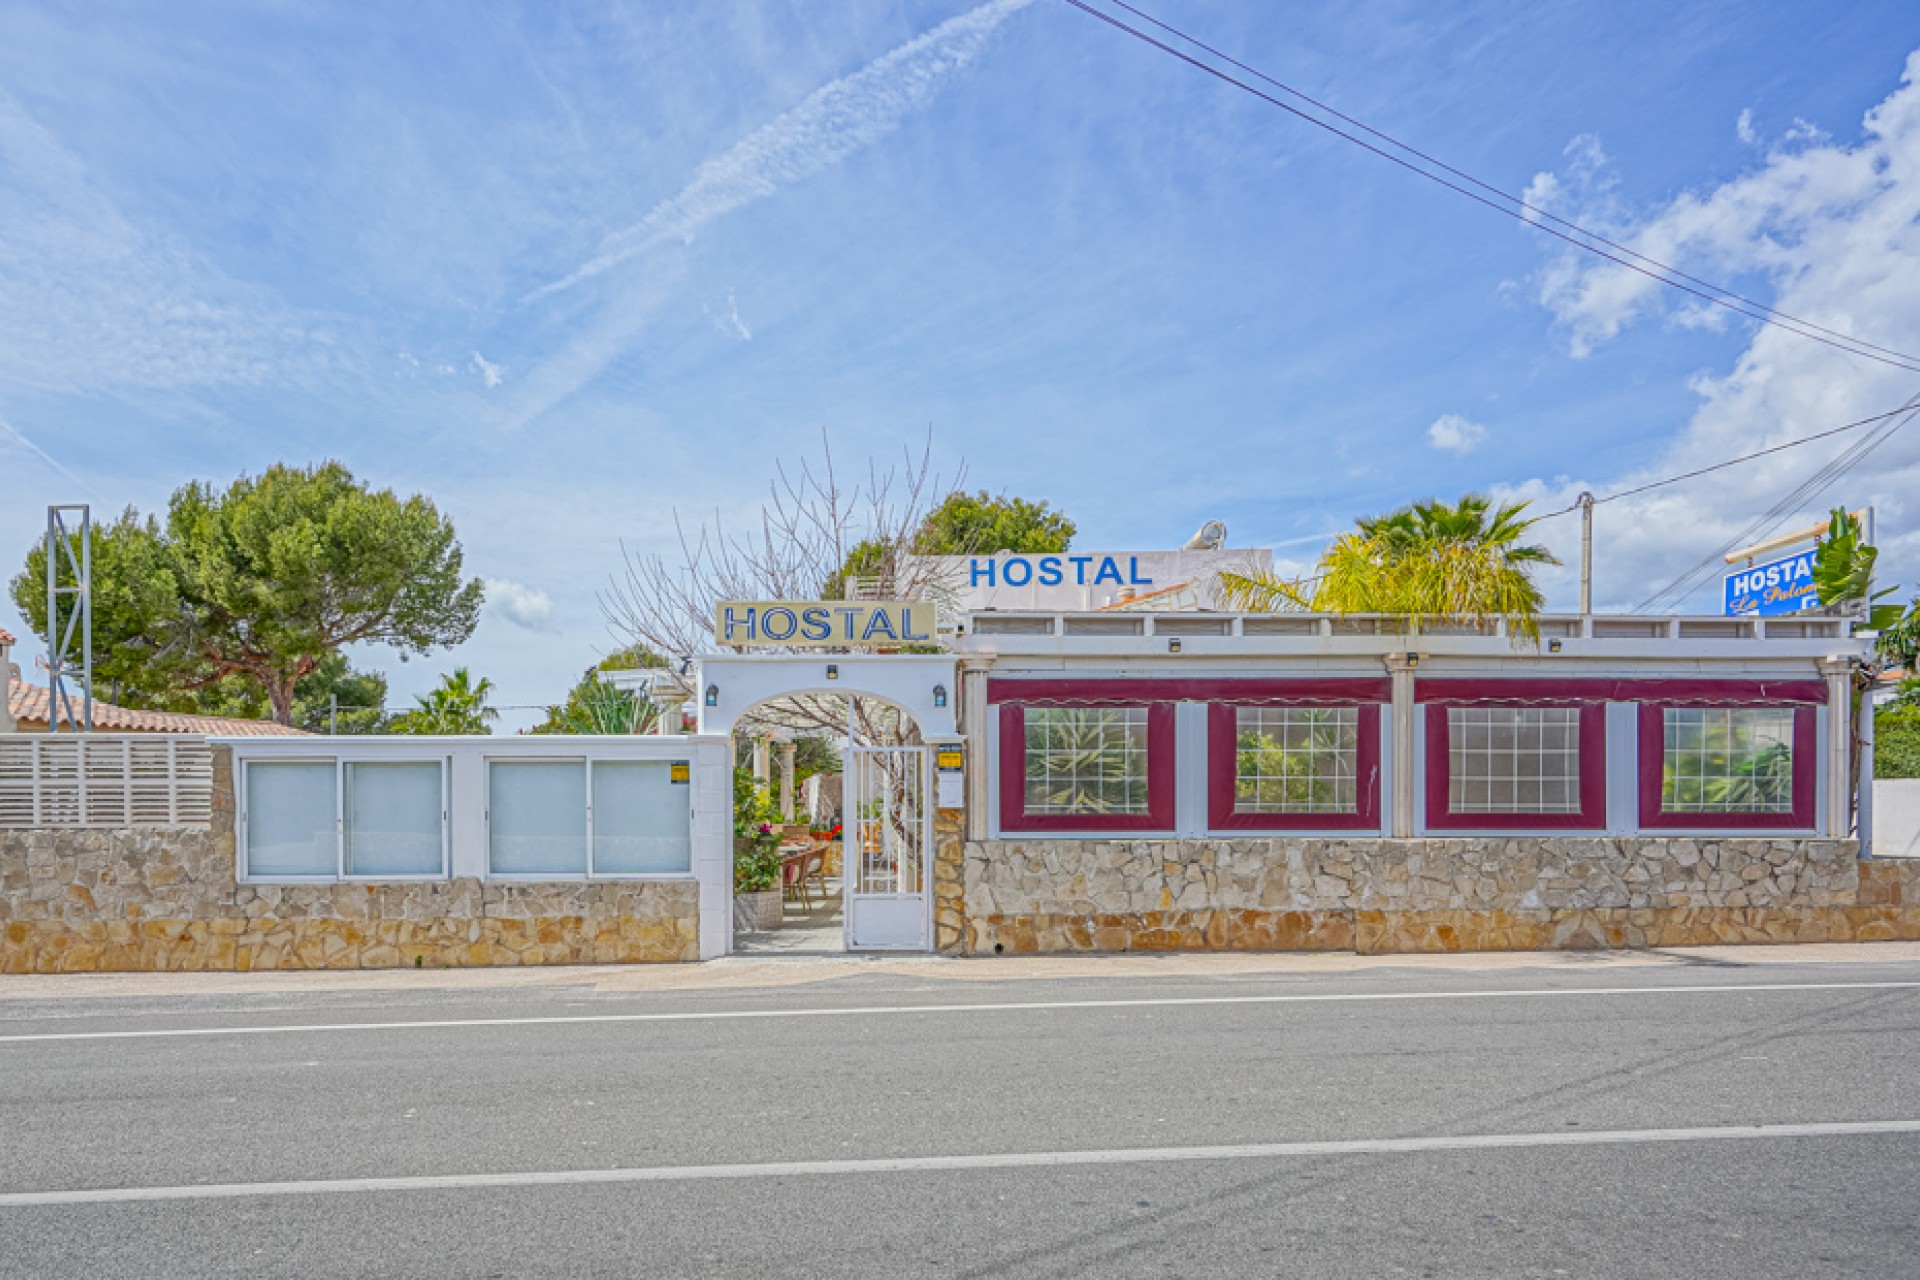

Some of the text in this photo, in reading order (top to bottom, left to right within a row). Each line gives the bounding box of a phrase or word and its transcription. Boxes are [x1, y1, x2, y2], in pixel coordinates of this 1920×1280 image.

[969, 556, 1153, 587] HOSTAL
[1763, 582, 1821, 605] Palom
[724, 606, 930, 641] HOSTAL
